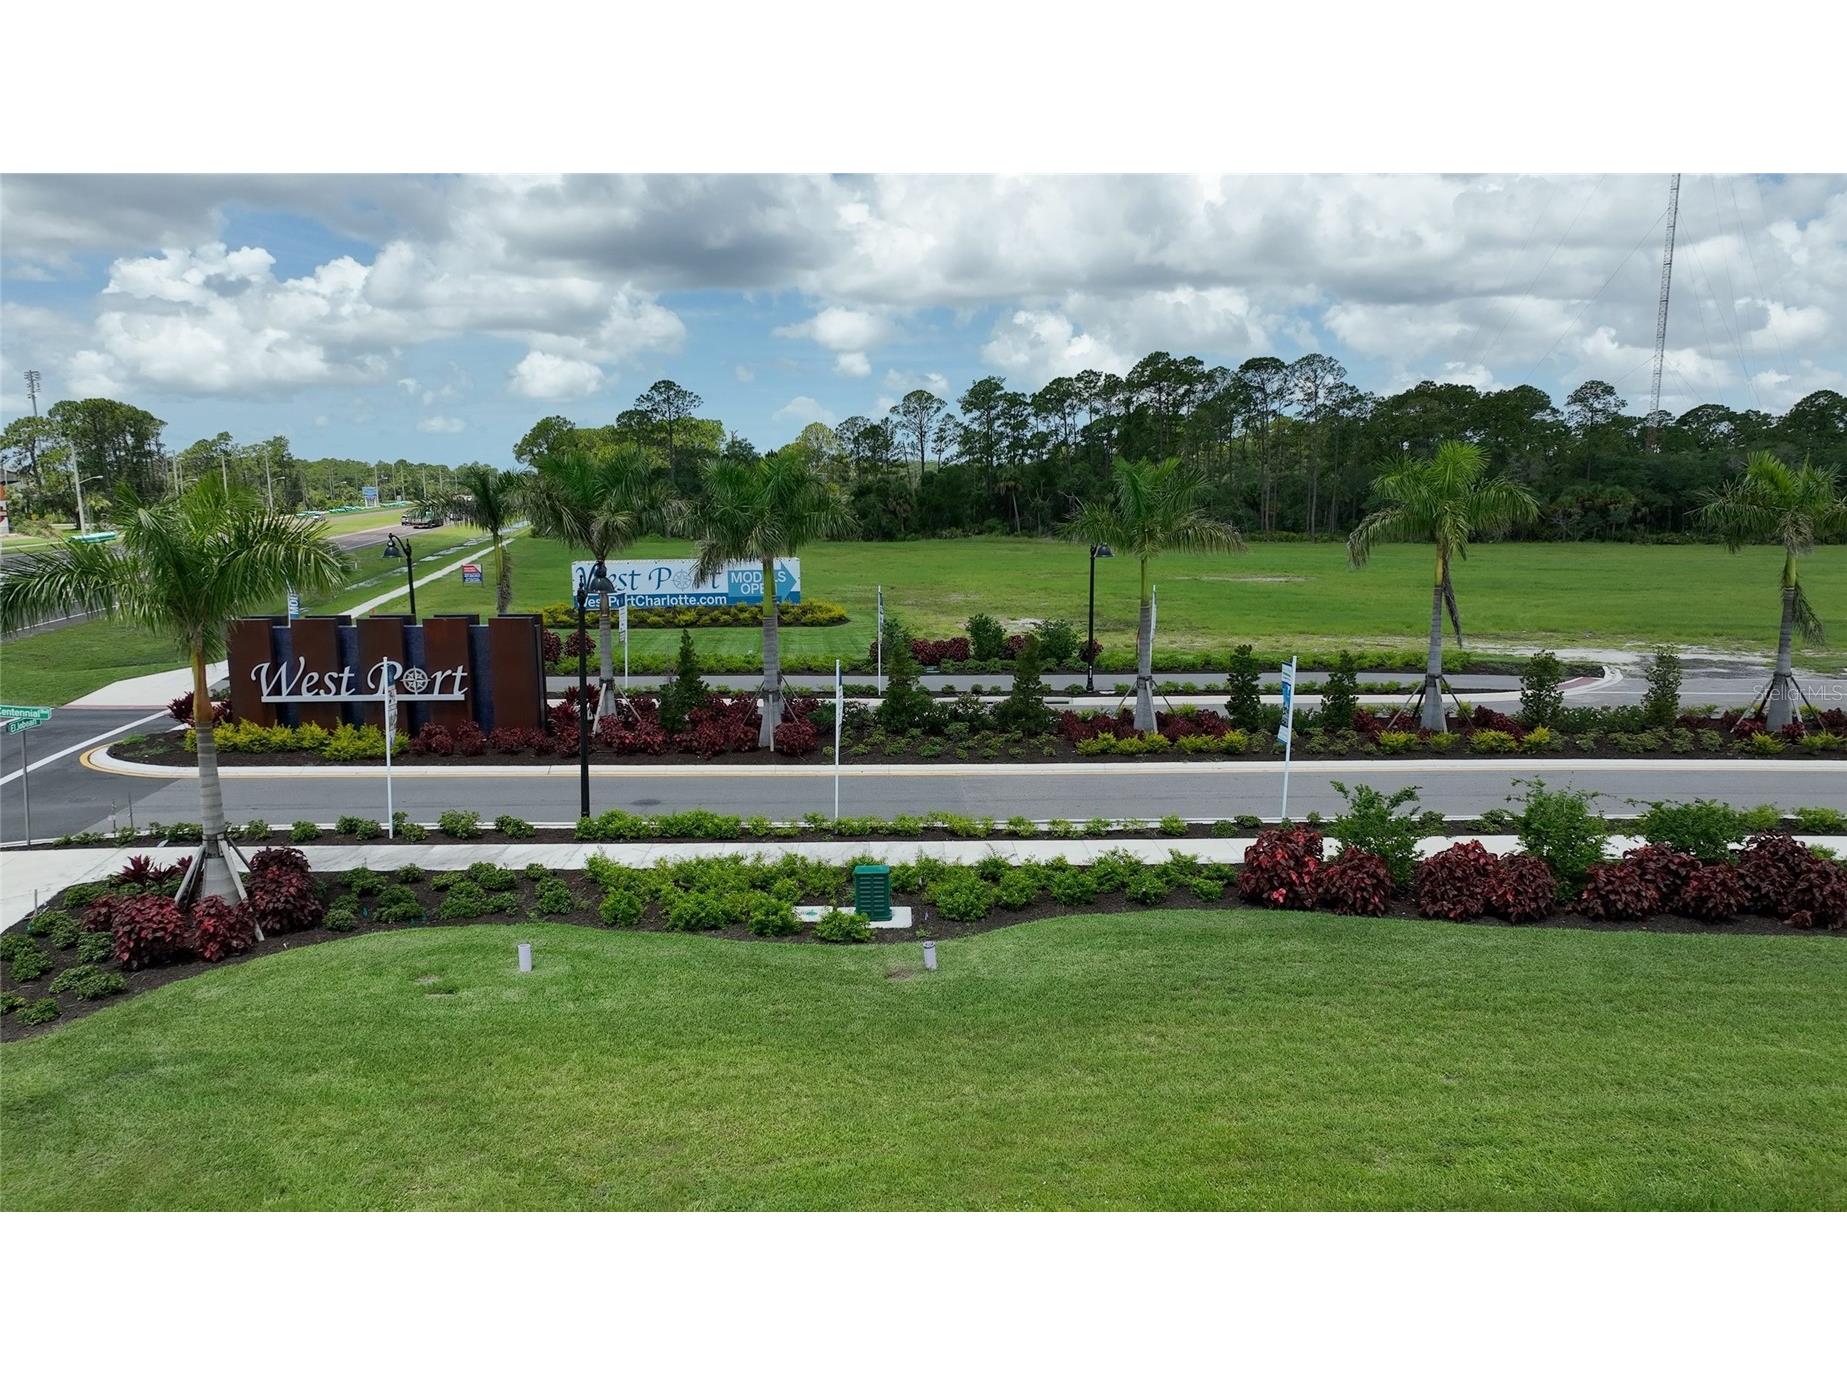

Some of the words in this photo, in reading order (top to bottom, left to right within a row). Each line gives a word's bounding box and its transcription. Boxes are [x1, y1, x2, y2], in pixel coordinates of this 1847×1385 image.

[730, 571, 787, 584] MODS
[740, 583, 778, 595] OPE
[250, 656, 356, 697] West
[0, 707, 40, 718] entennial
